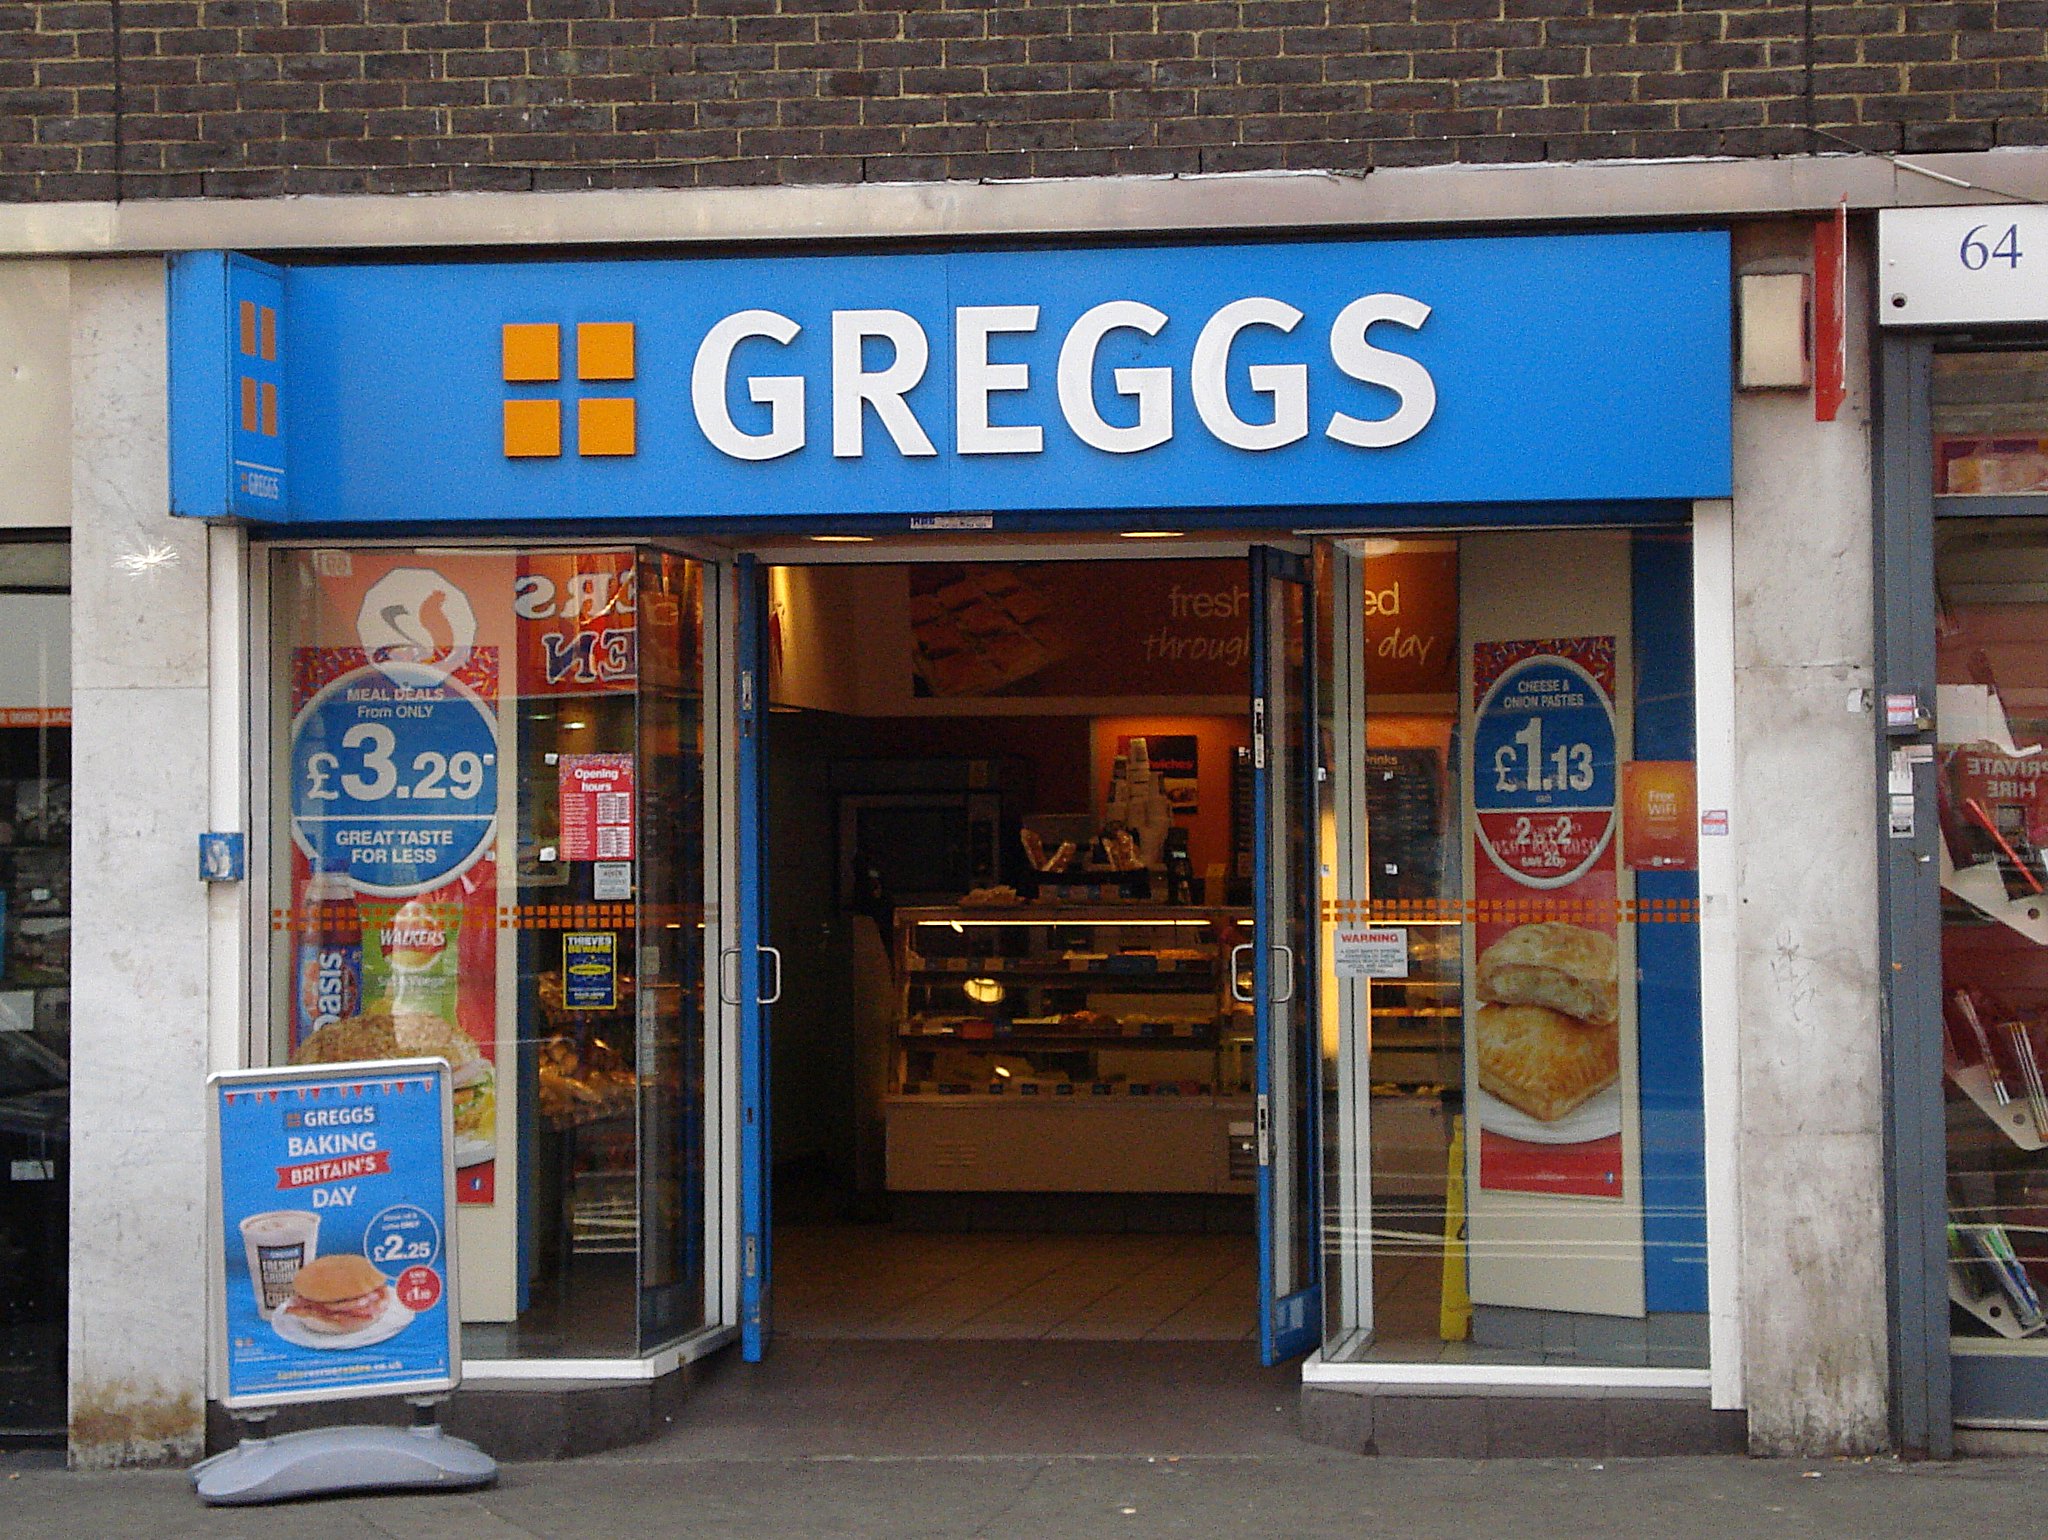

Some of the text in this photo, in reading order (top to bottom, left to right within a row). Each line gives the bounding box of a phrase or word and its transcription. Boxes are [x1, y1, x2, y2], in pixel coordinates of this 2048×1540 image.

[1960, 224, 2023, 271] 64
[691, 293, 1437, 461] GREGGS
[248, 472, 279, 500] GREGGS
[1142, 626, 1434, 667] throug day
[347, 687, 445, 702] MEAL DEALS
[1518, 679, 1560, 693] CHEESE
[357, 704, 435, 719] From ONLY
[1503, 693, 1585, 709] ONION PASTIES
[306, 722, 484, 801] £3.29
[1494, 716, 1595, 793] £1.13
[574, 768, 620, 781] Opening
[581, 781, 613, 793] hours
[335, 829, 454, 846] GREAT TASTE
[351, 849, 438, 864] FOR LESS
[380, 928, 447, 947] WALKERS
[1341, 933, 1399, 943] WARNING
[304, 1106, 376, 1128] GREGGS
[288, 1131, 378, 1157] BAKING
[290, 1156, 378, 1186] BRITAIN'S
[312, 1186, 358, 1208] DAY
[373, 1234, 431, 1262] £2.25
